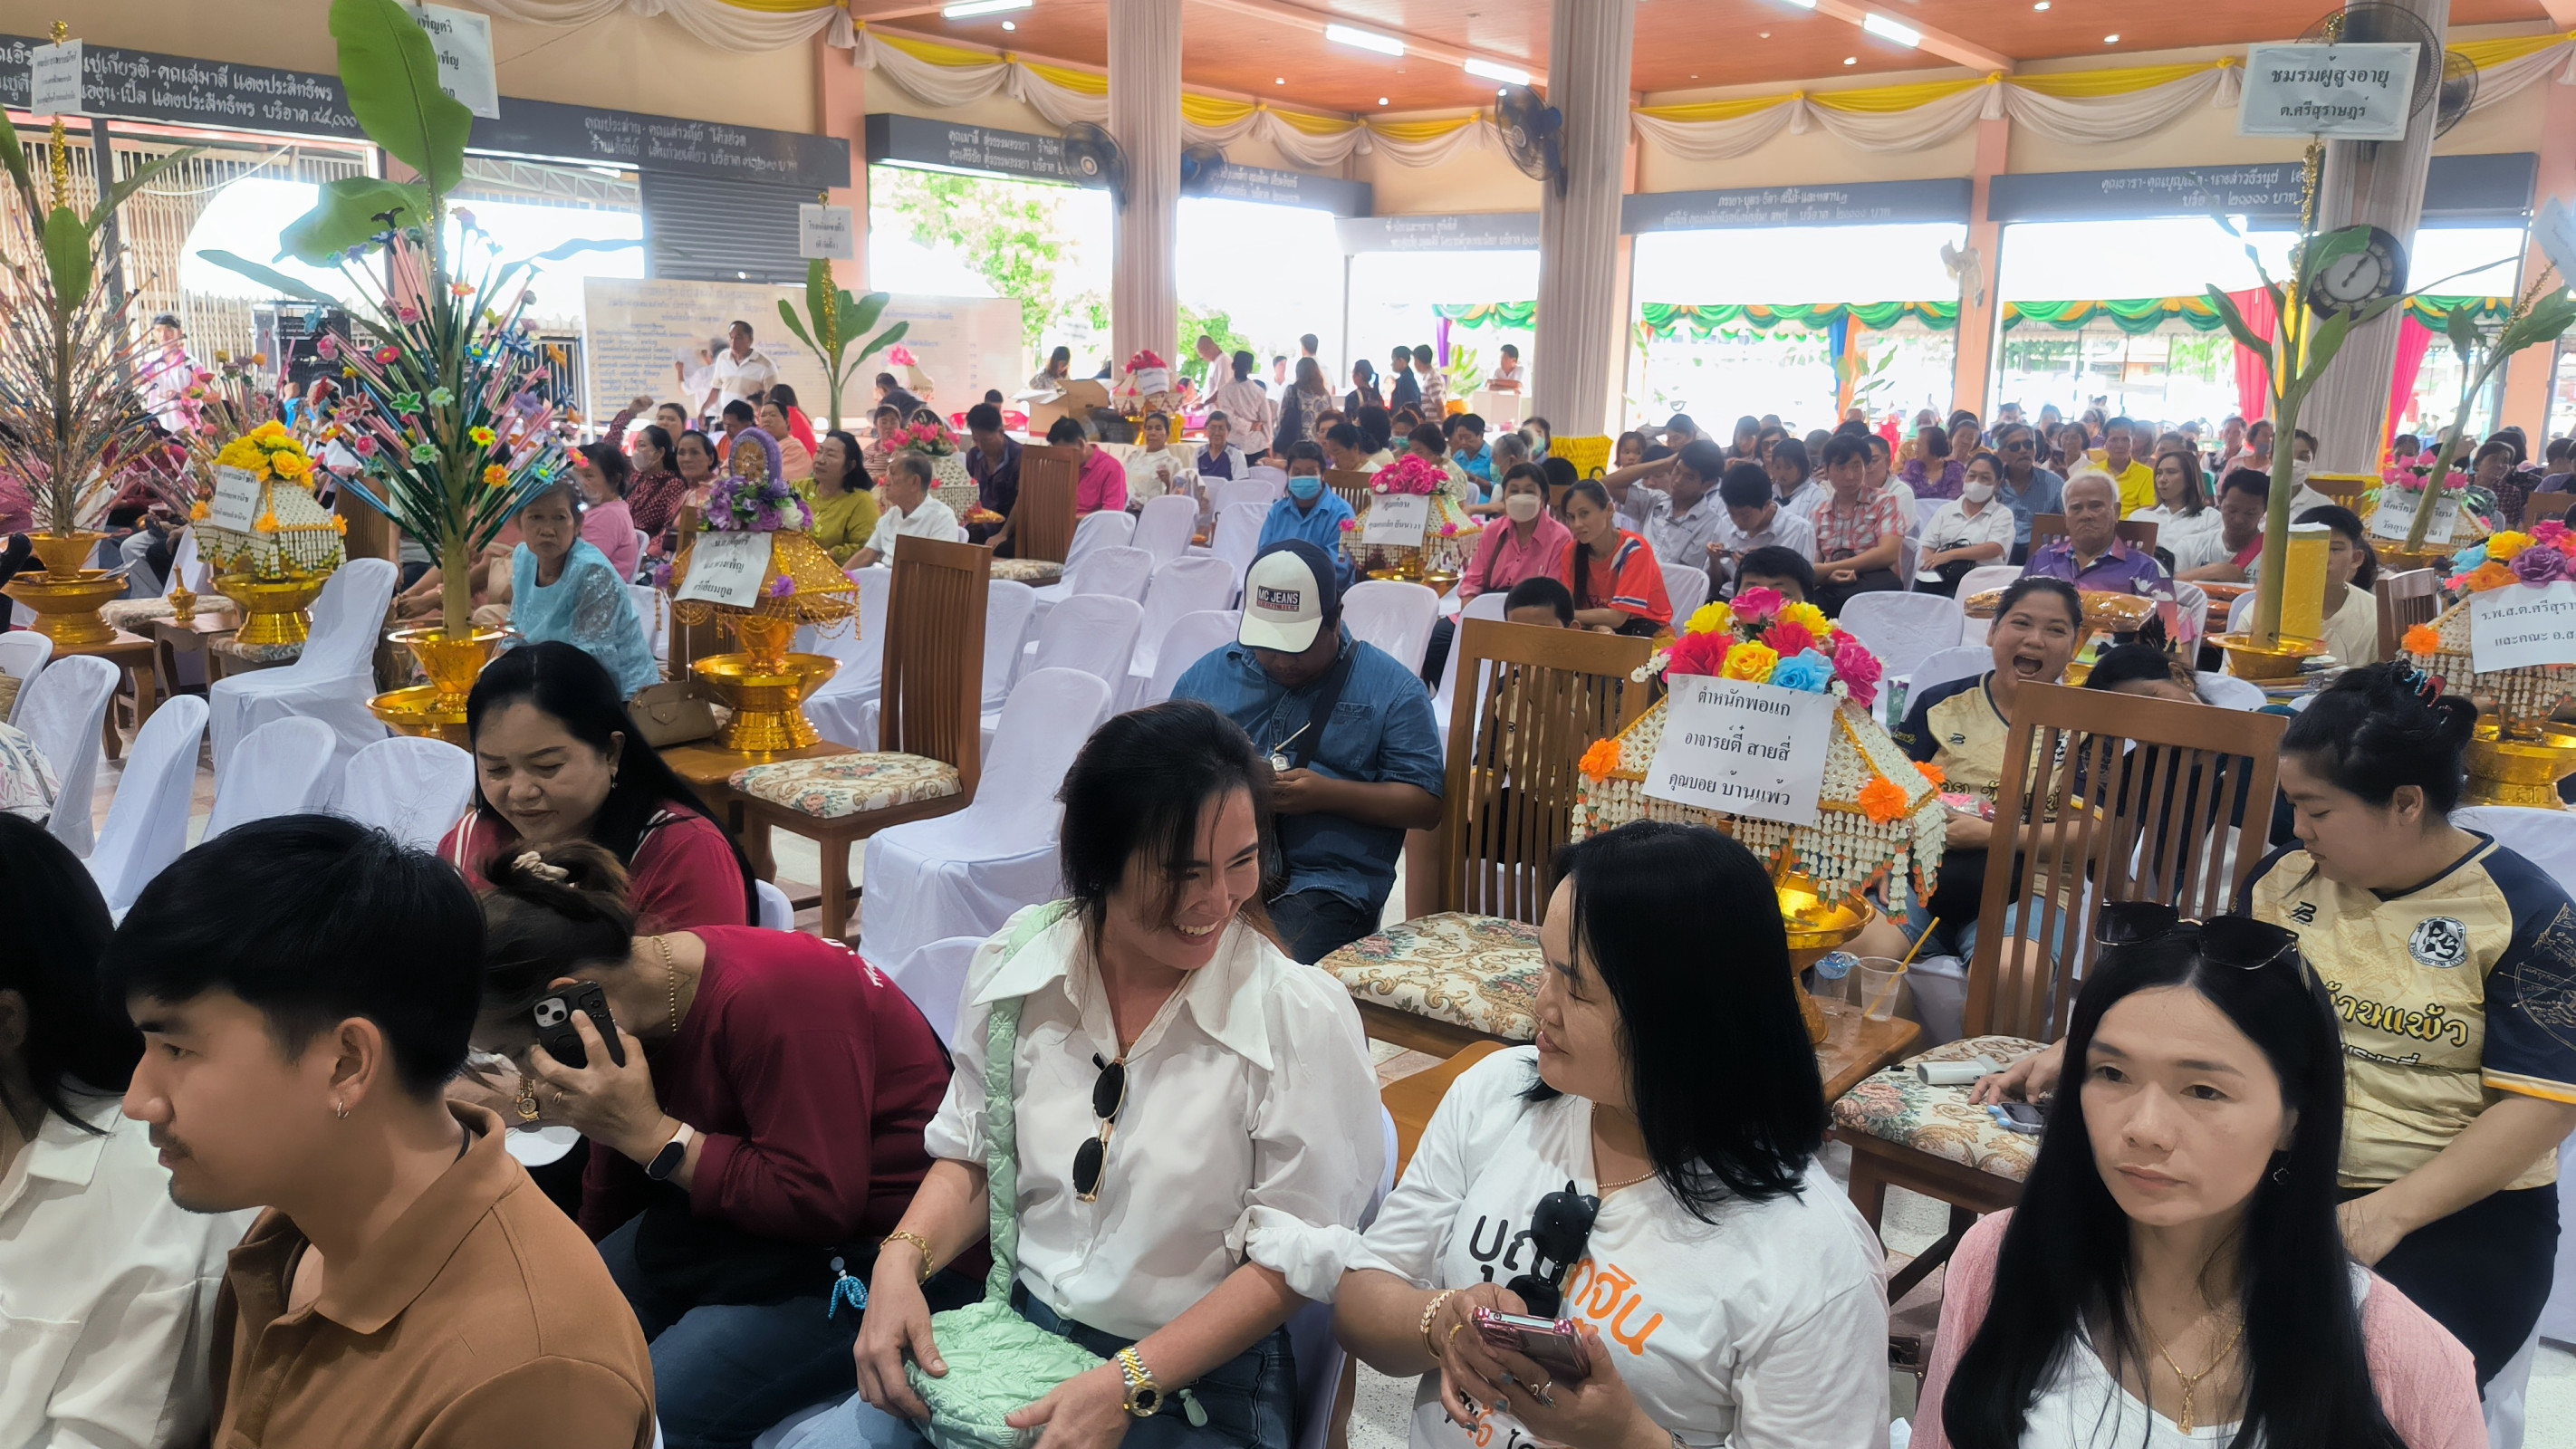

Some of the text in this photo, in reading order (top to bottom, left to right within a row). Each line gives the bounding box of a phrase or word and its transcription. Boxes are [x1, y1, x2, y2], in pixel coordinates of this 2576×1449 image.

[2272, 55, 2389, 88] ชมรมผู้สูงอายุ
[2280, 96, 2369, 120] ต.ศรีสุราษฎร์
[2182, 189, 2220, 207] บริจค
[1259, 589, 1299, 604] MC JEANS
[2494, 632, 2549, 647] และคณะ
[1698, 686, 1793, 716] ตำหนักพ่อแก่
[1685, 725, 1791, 762] อาจารย์ตี๋ สายสี่
[1669, 771, 1791, 806] คุณบอย บ้านแพ้ว
[2325, 982, 2468, 1048] ้านแพ้ว
